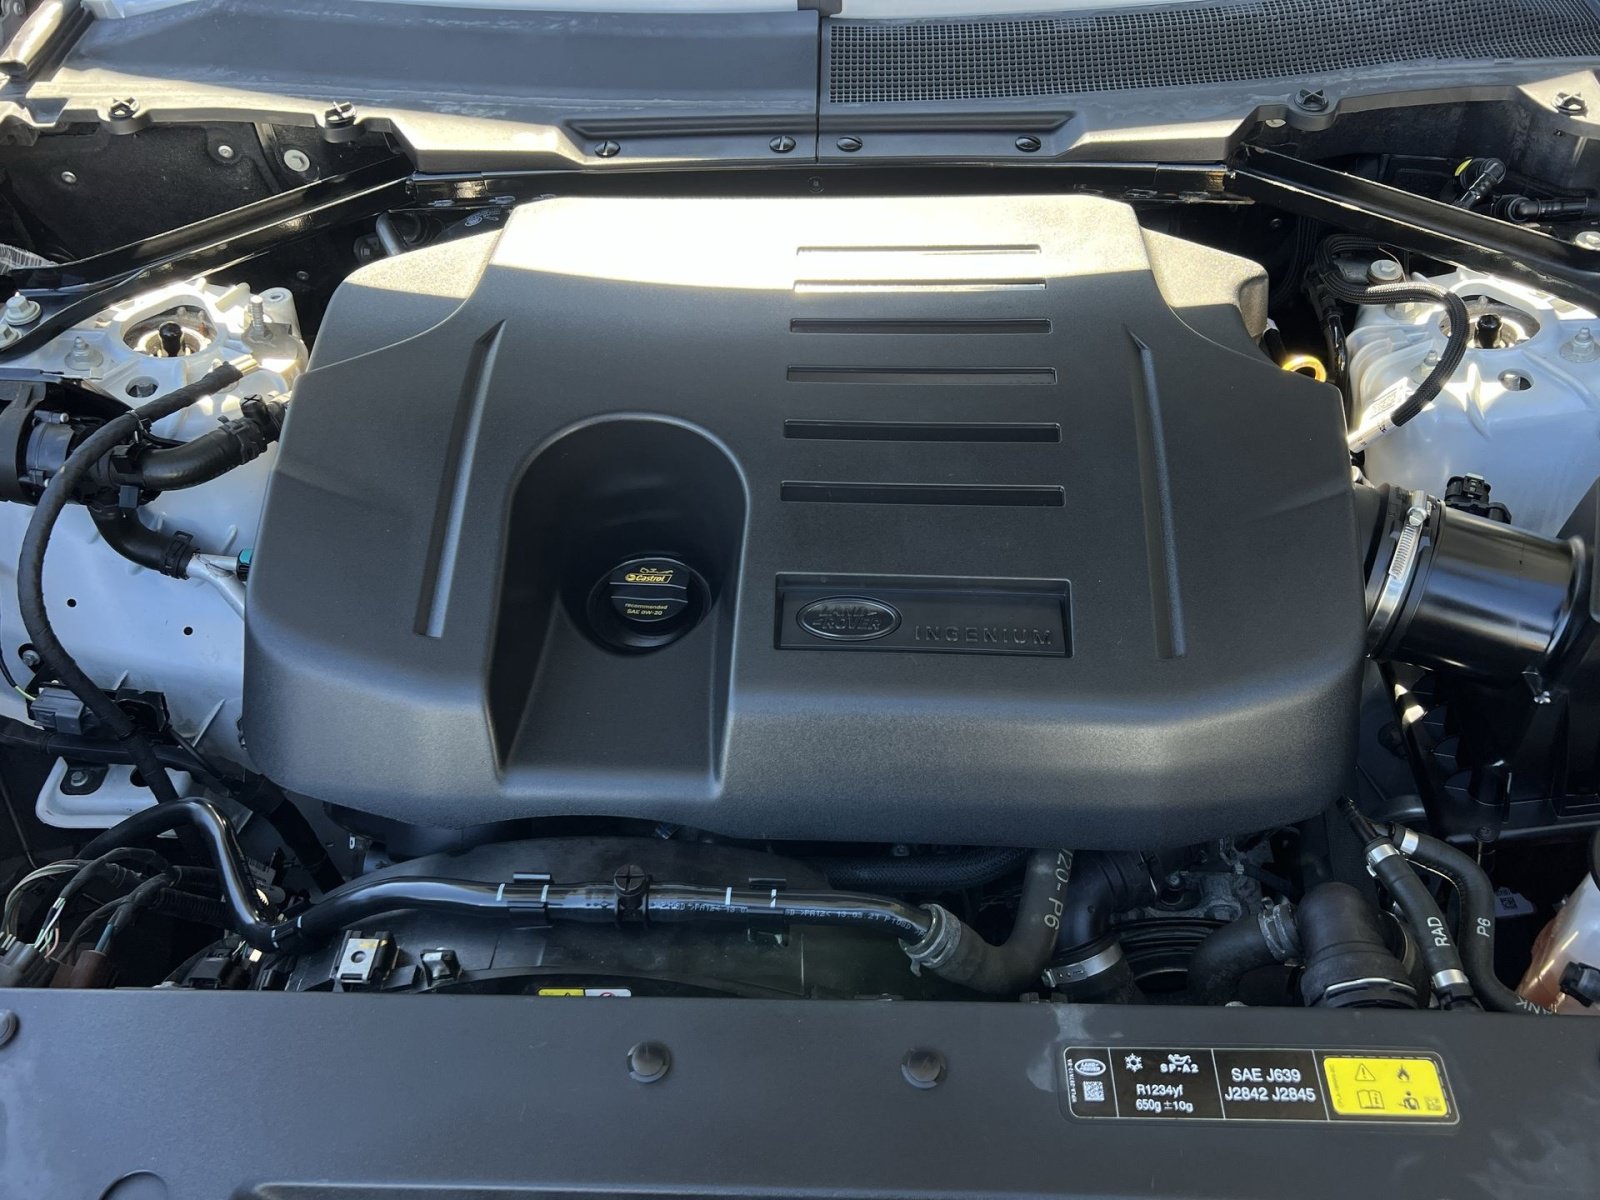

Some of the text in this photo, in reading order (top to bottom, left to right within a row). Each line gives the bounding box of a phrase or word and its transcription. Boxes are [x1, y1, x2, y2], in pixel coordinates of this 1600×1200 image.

[914, 624, 1052, 645] INGENIUM
[1044, 896, 1064, 930] P6
[1427, 916, 1451, 947] RAD
[1476, 917, 1491, 938] P6
[1231, 1067, 1302, 1083] SAE J639
[1135, 1083, 1185, 1098] R1234yf
[1224, 1085, 1317, 1103] J2842 J2845
[1135, 1098, 1195, 1113] 650g ±10g
